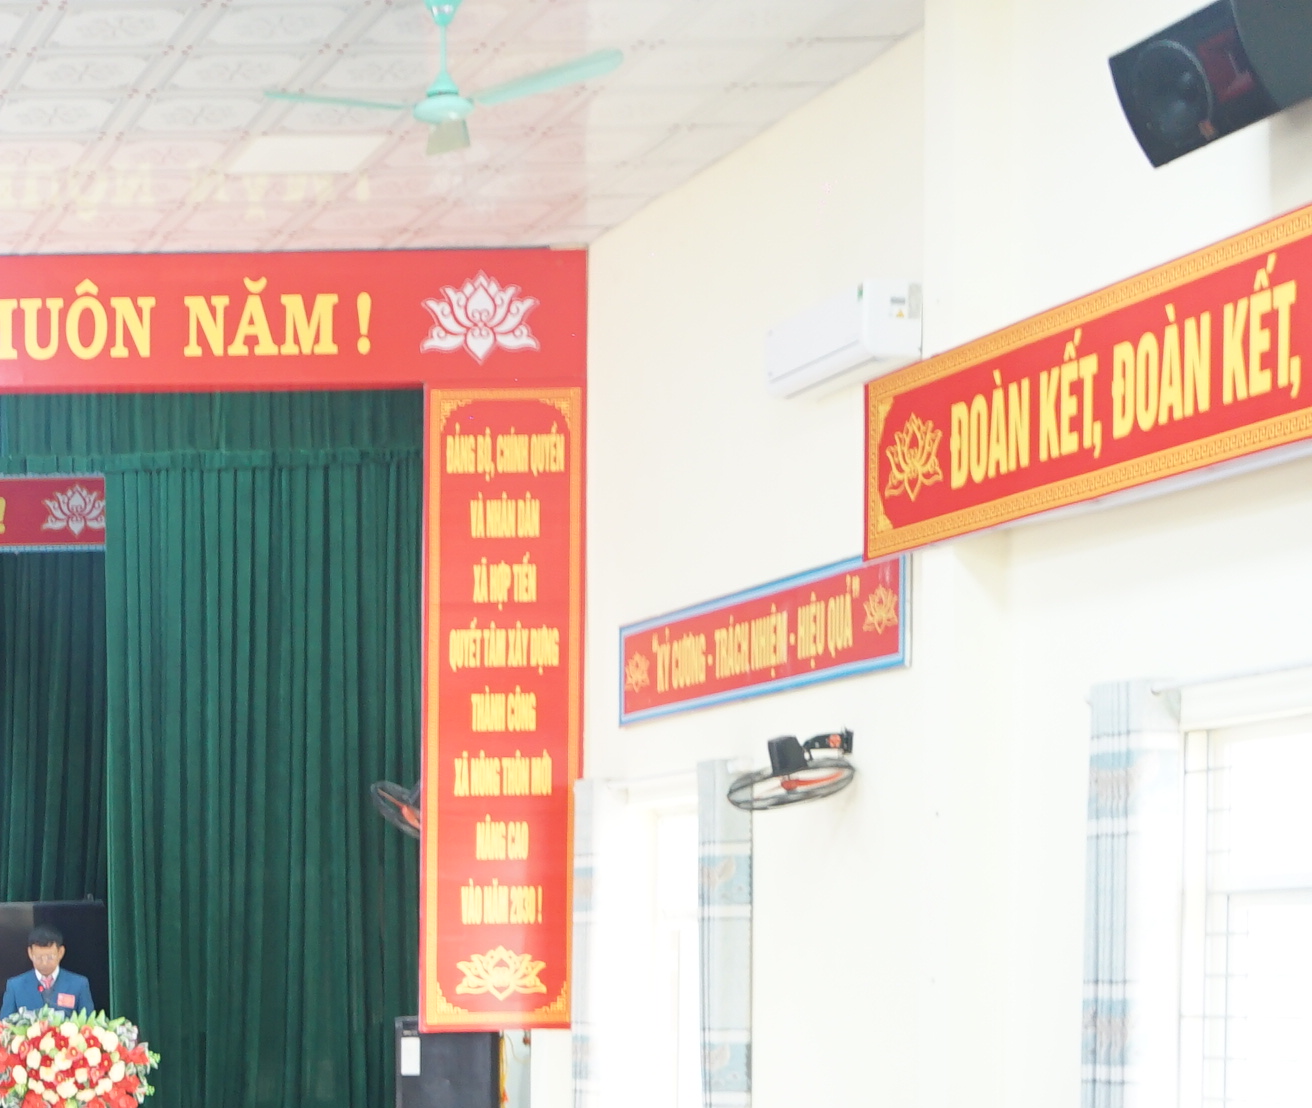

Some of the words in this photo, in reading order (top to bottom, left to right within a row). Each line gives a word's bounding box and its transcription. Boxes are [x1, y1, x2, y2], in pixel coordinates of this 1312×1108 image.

[950, 368, 1031, 490] ĐOÀN
[1038, 327, 1103, 459] KẾT,
[1111, 303, 1211, 440] ĐOÀN
[1222, 252, 1301, 404] KẾT,
[446, 422, 475, 474] ĐẢNG
[496, 426, 529, 474] CHÍNH
[530, 421, 565, 477] QUYỀN
[470, 491, 485, 538] VÀ
[486, 491, 516, 538] NHÂN
[517, 491, 540, 538] DÂN
[473, 556, 488, 603] XÃ
[489, 560, 511, 611] HỢP
[512, 551, 537, 603] TIẾN
[449, 617, 482, 672] QUYẾT
[483, 620, 506, 668] TÂM
[507, 620, 530, 668] XÂY
[530, 624, 560, 675] DỰNG
[714, 614, 749, 680] TRÁCH
[750, 602, 788, 679] NHIỆM
[797, 591, 825, 669] HIỆU
[471, 685, 506, 732] THÀNH
[507, 685, 536, 732] CÔNG
[454, 750, 469, 797] XÃ
[470, 750, 501, 797] NÔNG
[501, 750, 530, 796] THÔN
[530, 749, 552, 796] MỚI
[475, 814, 506, 861] NÂNG
[507, 821, 529, 861] CAO
[460, 878, 483, 925] VÀO
[483, 878, 509, 925] NĂM
